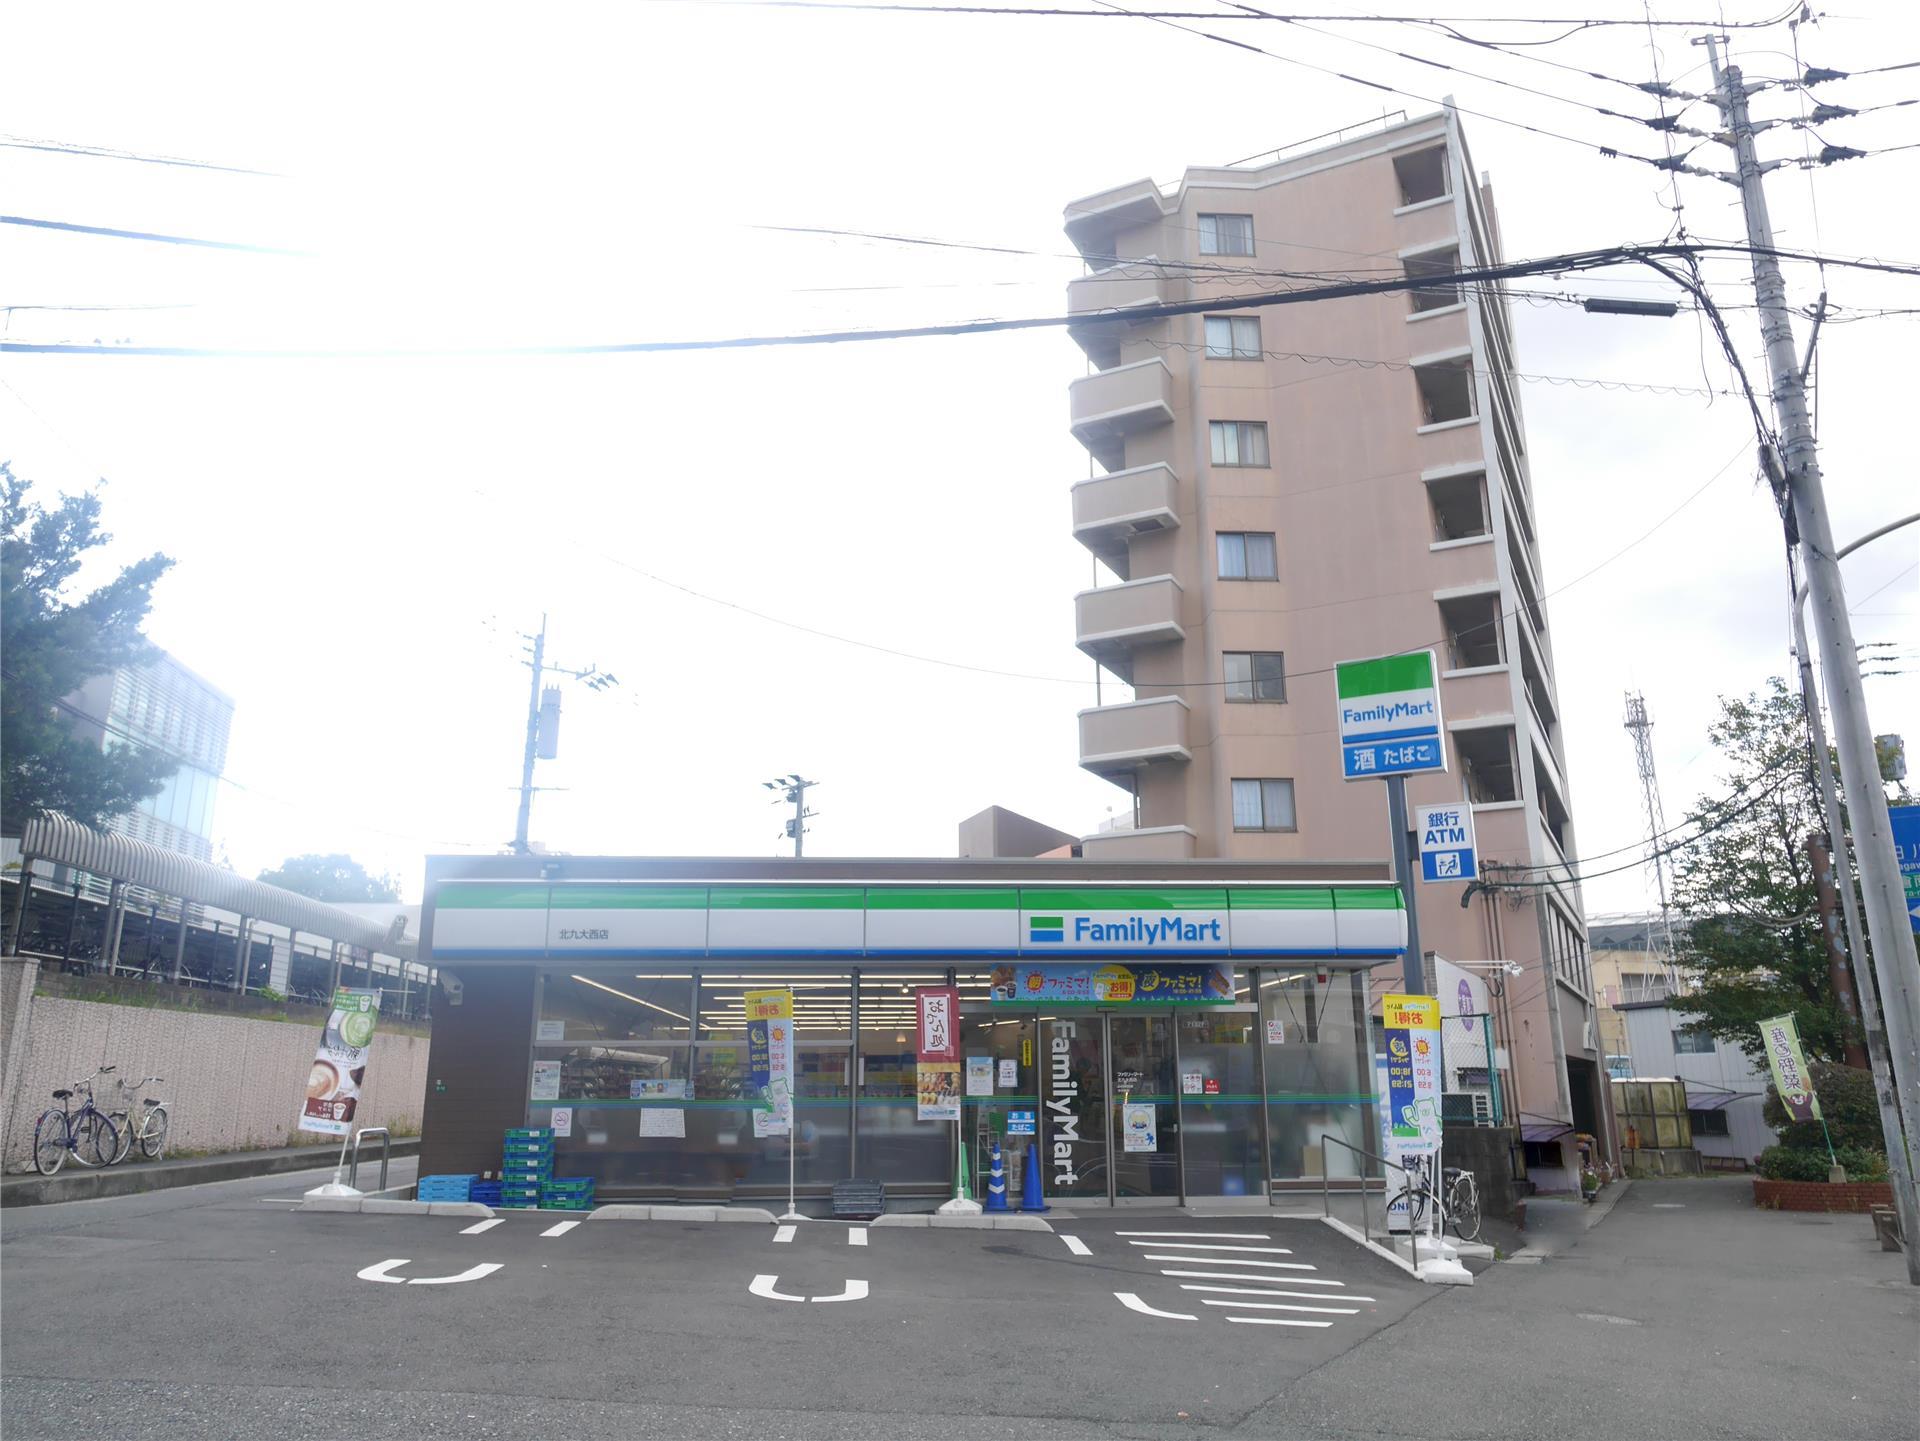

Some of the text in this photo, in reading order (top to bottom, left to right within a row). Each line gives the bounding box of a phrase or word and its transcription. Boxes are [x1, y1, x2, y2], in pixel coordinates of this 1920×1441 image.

[1343, 701, 1433, 723] FamilyMart
[1354, 745, 1431, 770] 酒 たばこ
[1428, 811, 1459, 827] 銀行
[1424, 827, 1465, 844] ATM
[559, 928, 609, 940] 北九大西店
[1075, 917, 1221, 945] FamilyMart
[1046, 1020, 1080, 1186] FamilyMart
